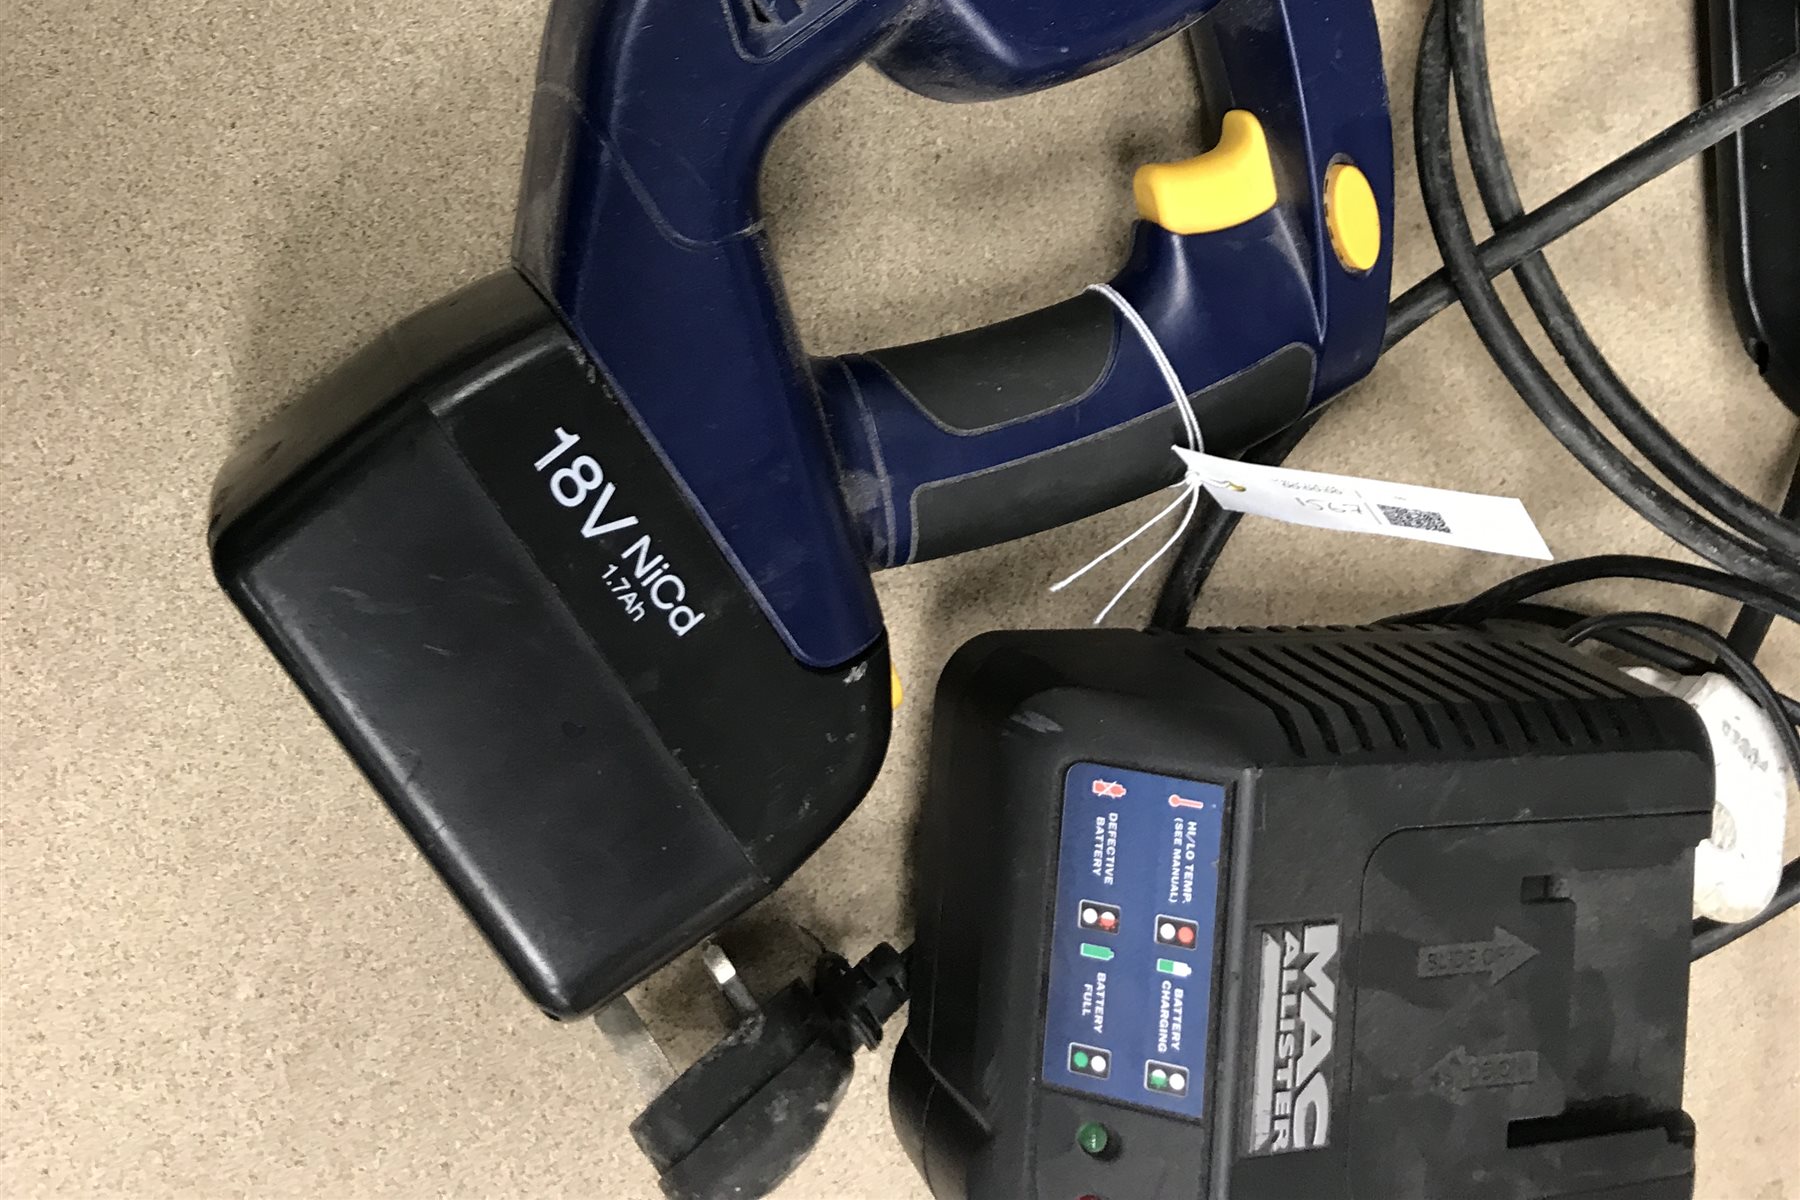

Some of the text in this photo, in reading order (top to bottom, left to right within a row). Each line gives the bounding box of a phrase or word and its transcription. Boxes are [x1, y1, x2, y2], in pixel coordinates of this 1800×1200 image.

[533, 426, 706, 638] 18V NiCd
[601, 563, 647, 623] 1.7Ah
[1092, 816, 1106, 877] BATTERY
[1103, 812, 1119, 885] DEFECTIVE
[1168, 817, 1184, 904] (SEE MANUAL)
[1182, 821, 1198, 904] HI/LO TEMP.
[1081, 983, 1094, 1016] FULL
[1093, 972, 1107, 1034] BATTERY
[1157, 980, 1172, 1053] CHARGING
[1171, 987, 1184, 1051] BATTERY
[1293, 924, 1340, 1148] MAC
[1272, 930, 1300, 1152] ALLISTER
